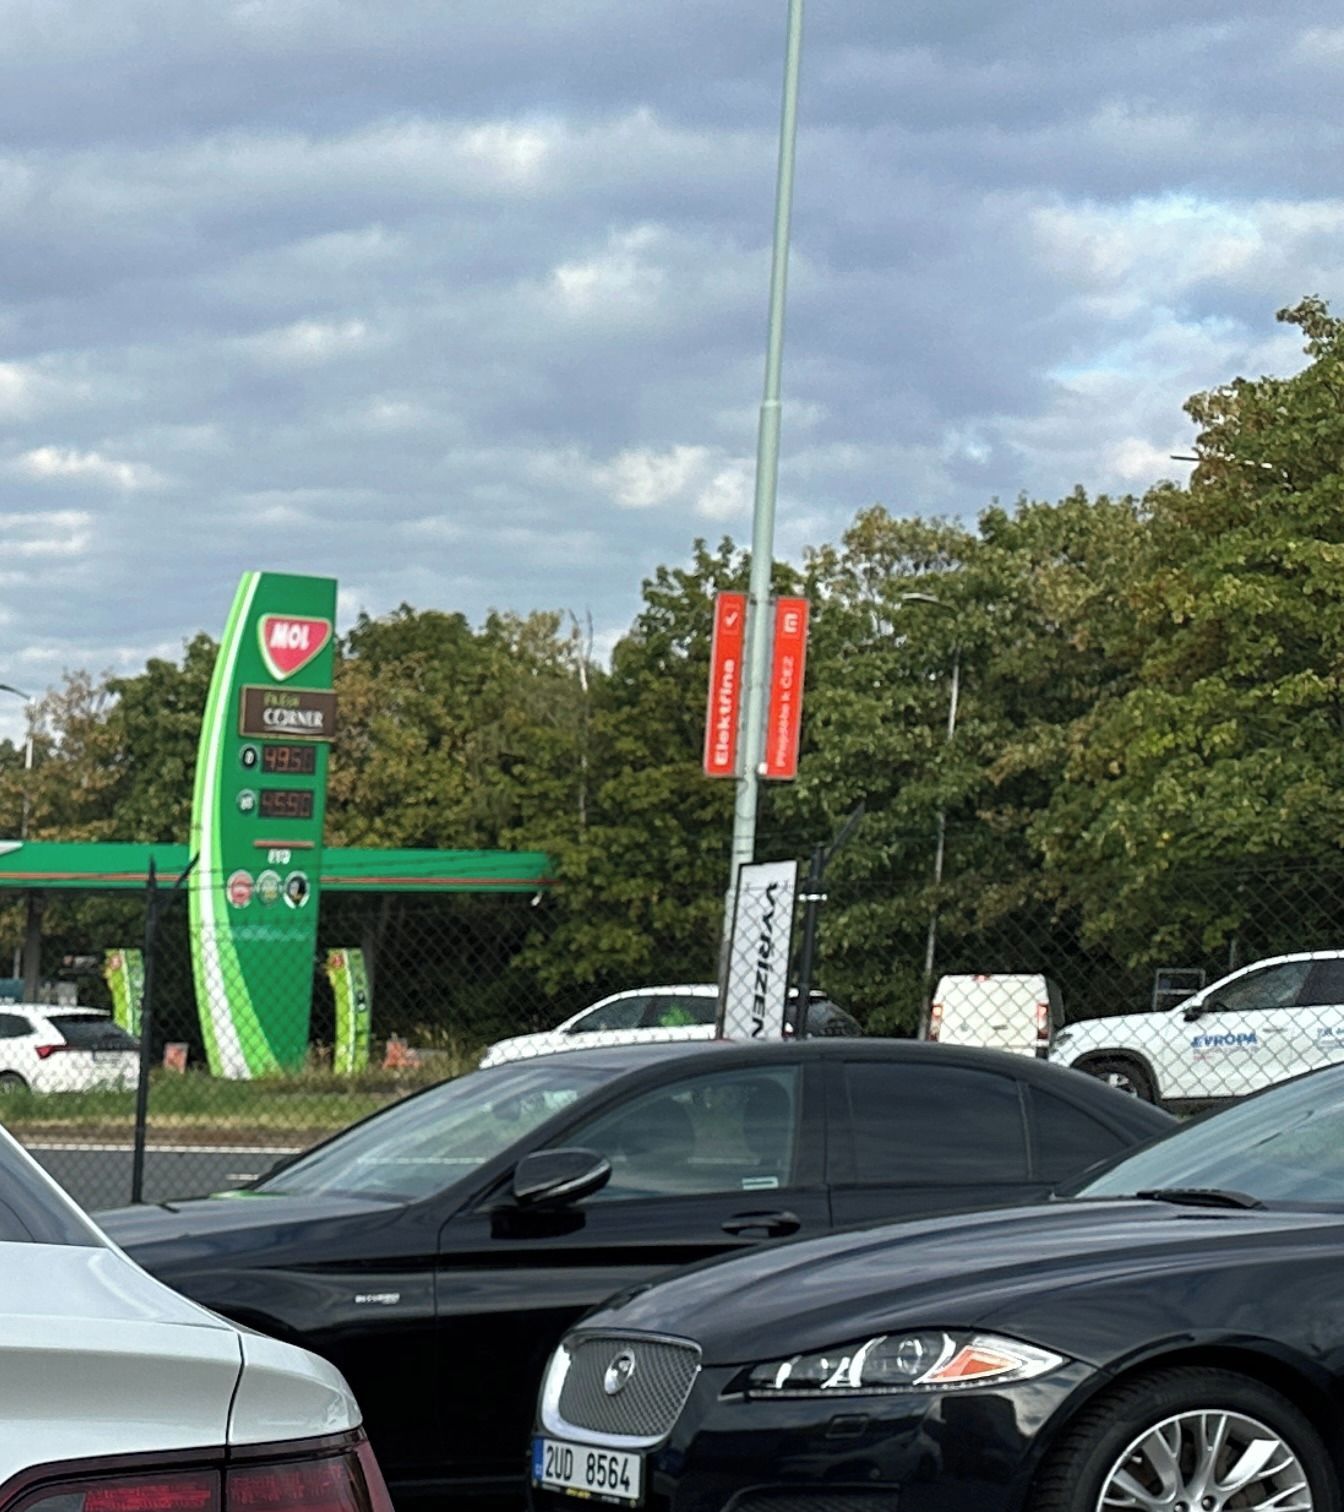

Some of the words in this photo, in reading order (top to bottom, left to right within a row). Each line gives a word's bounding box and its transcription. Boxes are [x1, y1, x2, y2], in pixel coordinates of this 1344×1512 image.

[269, 622, 310, 650] MOL
[263, 708, 323, 728] CORNER
[545, 1446, 573, 1481] 2UD
[586, 1453, 631, 1492] 8564
